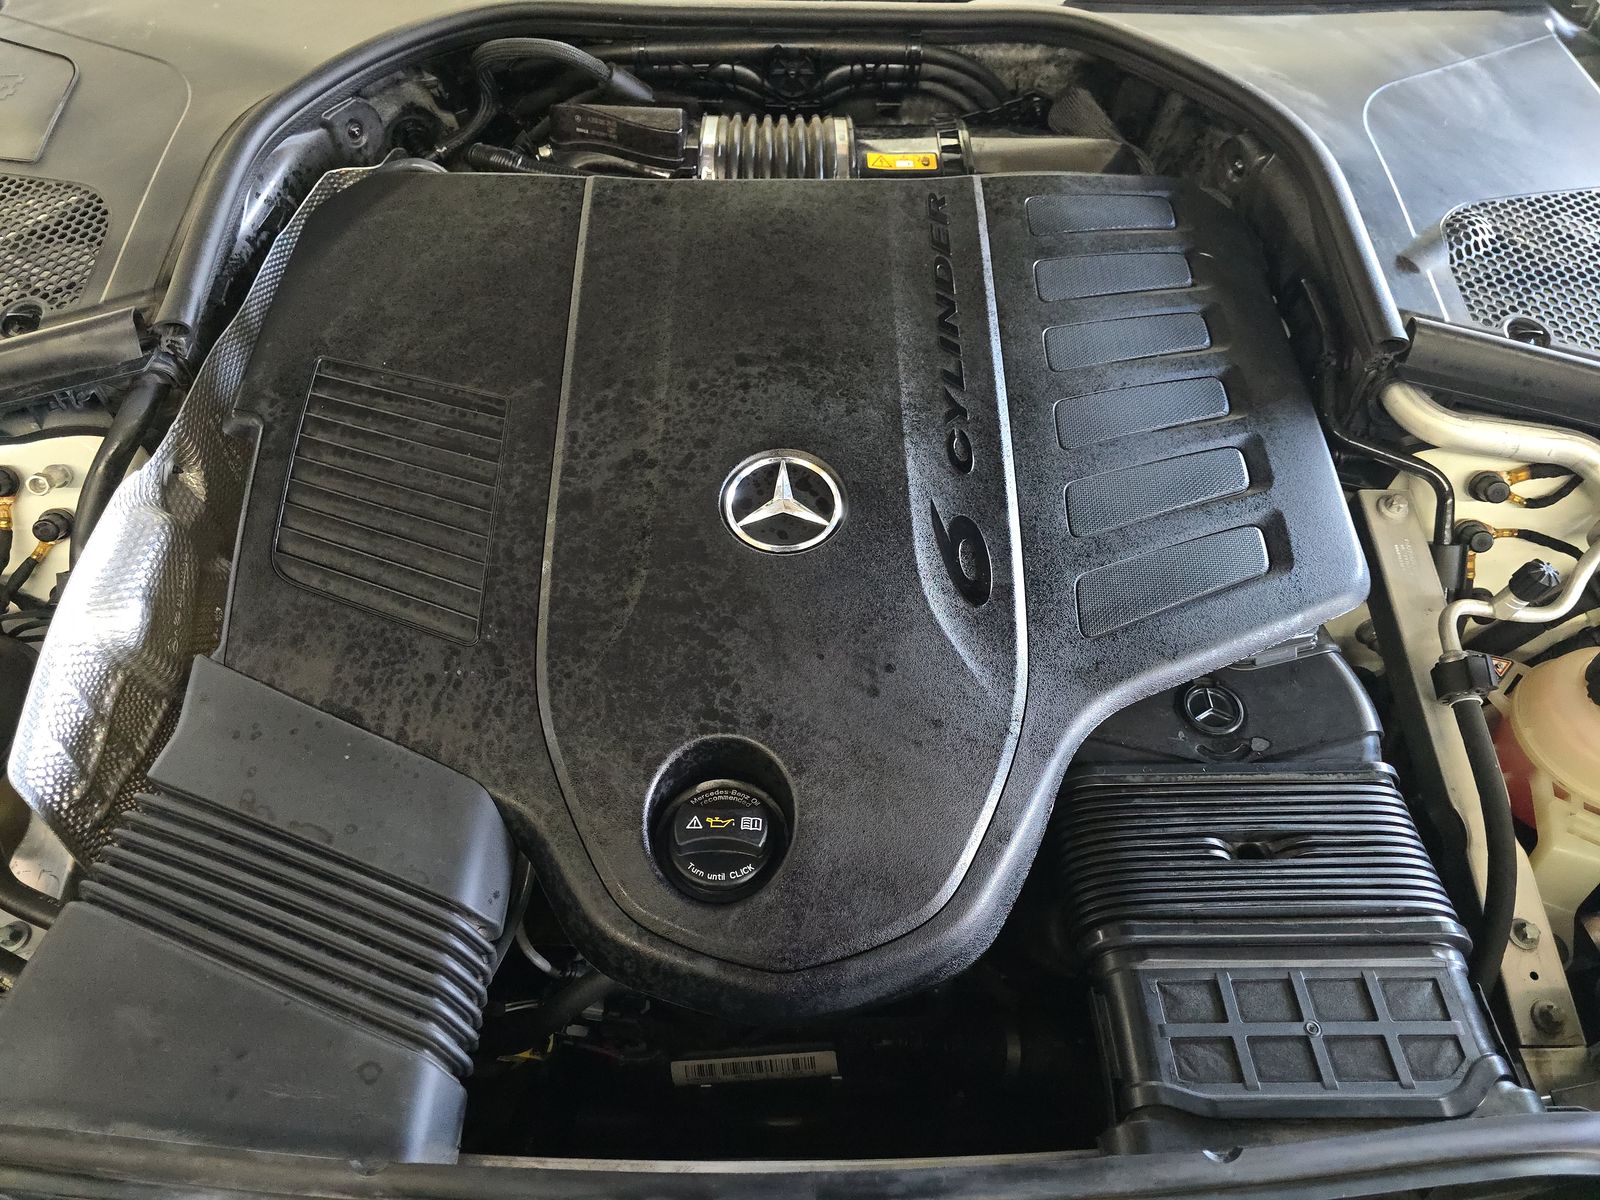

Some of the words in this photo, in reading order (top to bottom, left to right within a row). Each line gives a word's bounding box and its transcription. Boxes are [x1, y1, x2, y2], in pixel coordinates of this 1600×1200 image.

[927, 192, 975, 475] CYLINDER
[931, 499, 993, 608] 6
[690, 789, 751, 805] Mercedes-Benz
[751, 797, 761, 807] Oil
[700, 795, 751, 808] recommended
[687, 862, 704, 877] Turn
[707, 873, 726, 881] until
[729, 863, 755, 880] CLICK
